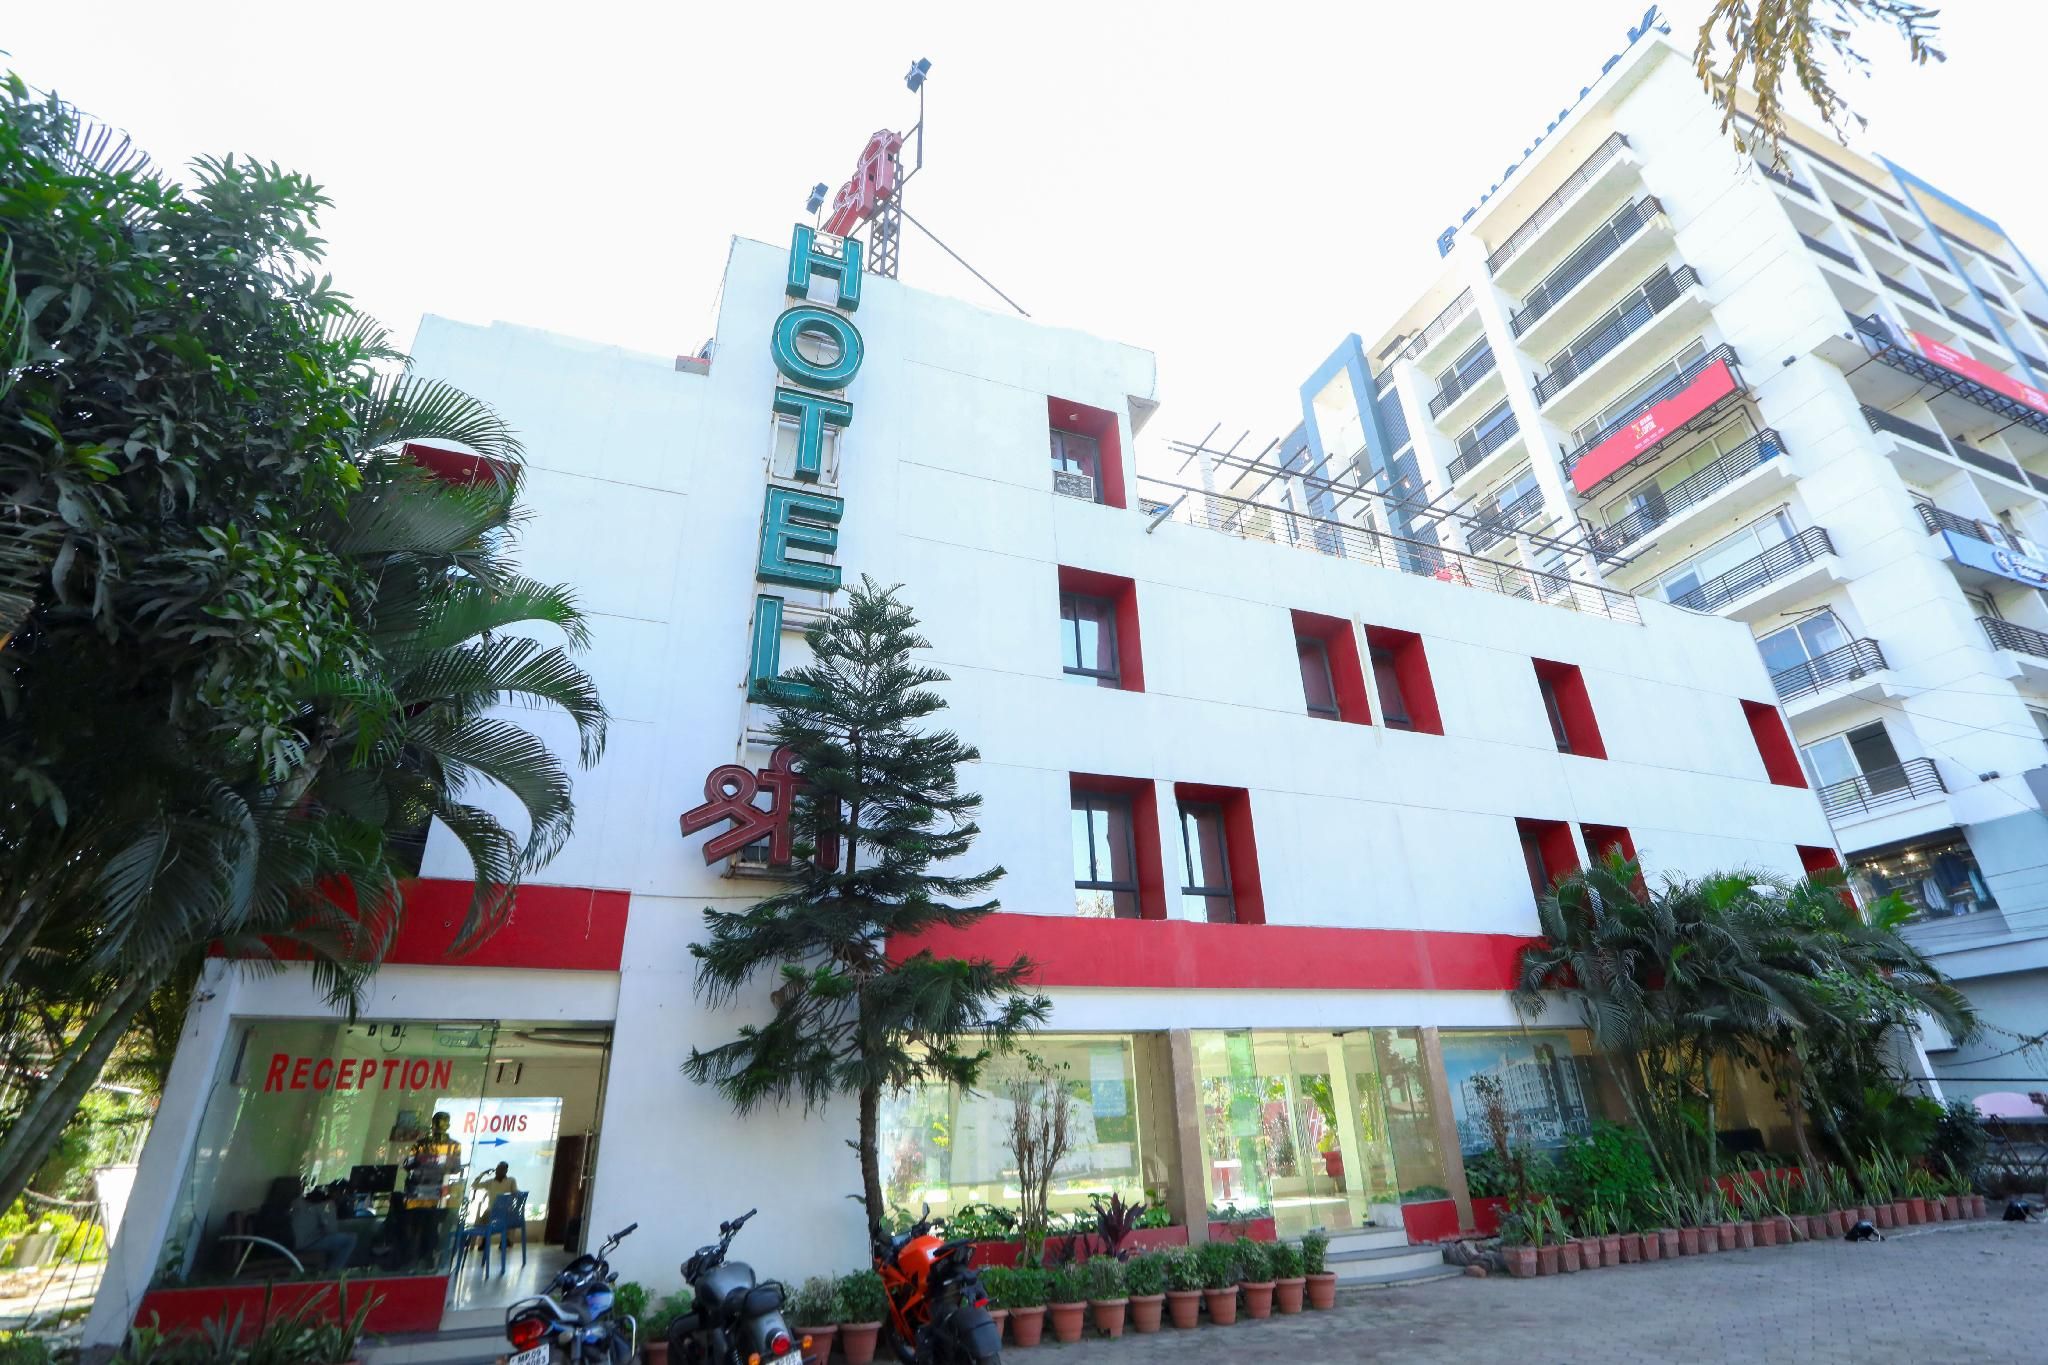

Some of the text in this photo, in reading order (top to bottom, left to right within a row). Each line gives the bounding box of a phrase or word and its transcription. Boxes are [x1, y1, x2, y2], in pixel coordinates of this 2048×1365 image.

[746, 222, 865, 704] HOTEL
[264, 1053, 453, 1092] RECEPTION
[463, 1111, 528, 1133] ROOMS
